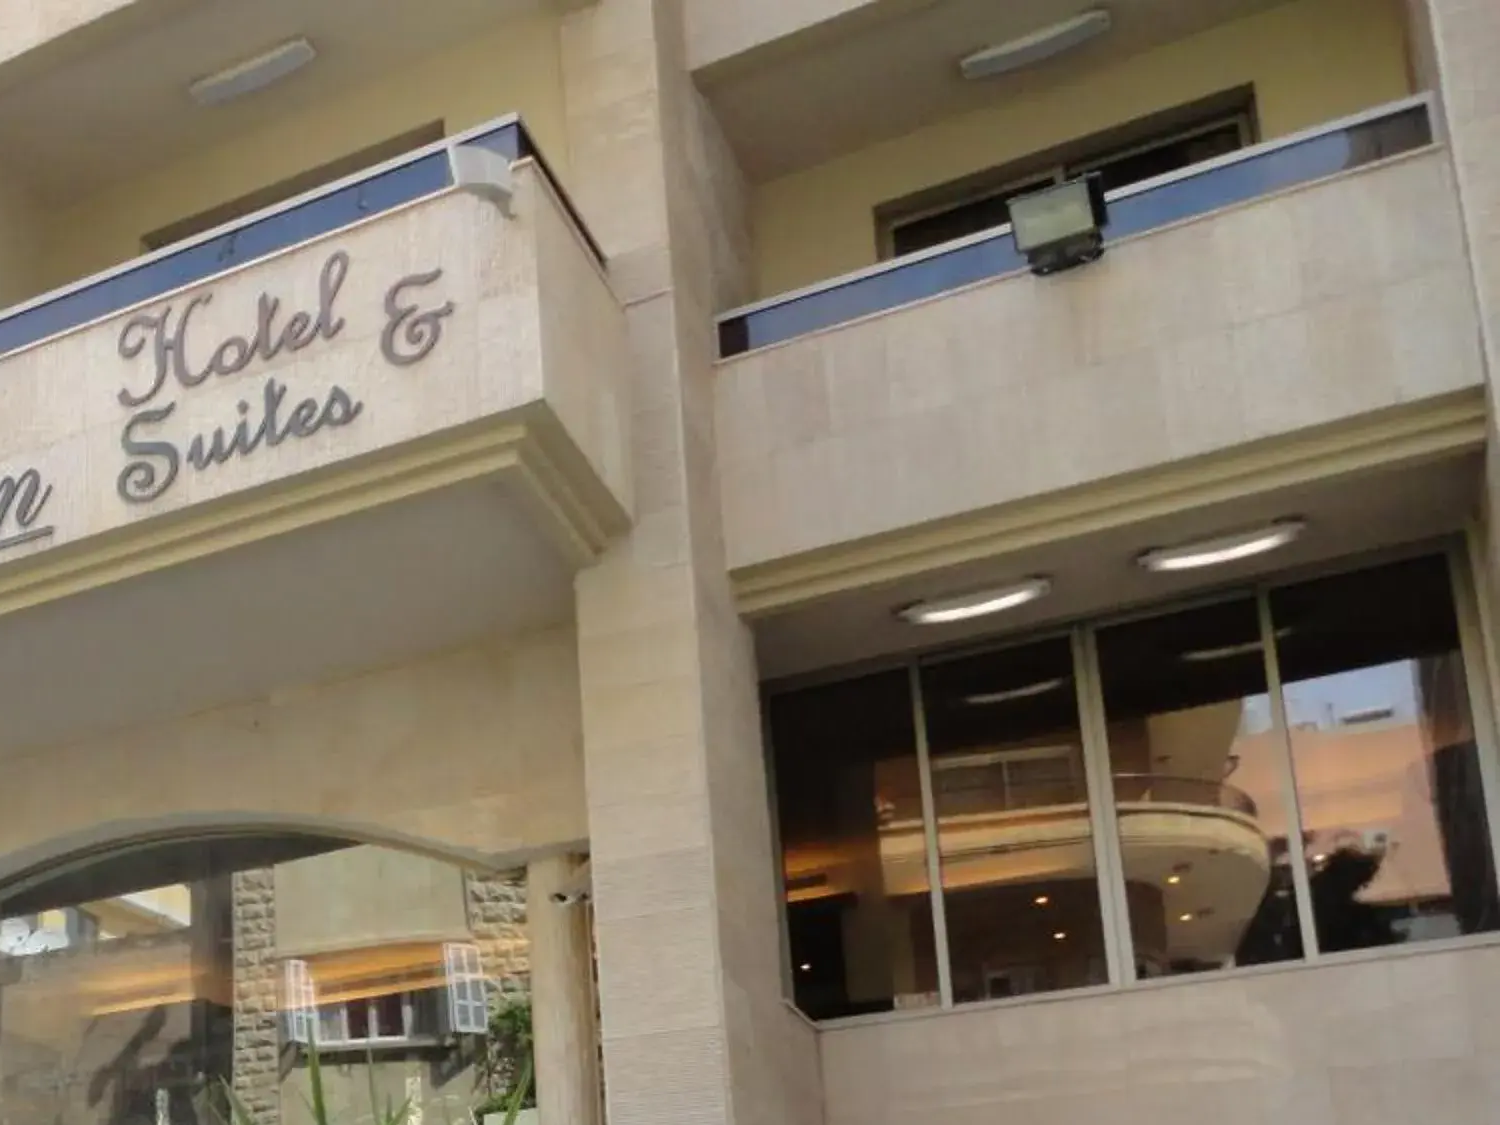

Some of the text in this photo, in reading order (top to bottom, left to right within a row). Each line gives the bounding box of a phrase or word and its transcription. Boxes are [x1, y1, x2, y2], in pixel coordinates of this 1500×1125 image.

[117, 249, 454, 407] Hotel &
[116, 377, 364, 502] Suites
